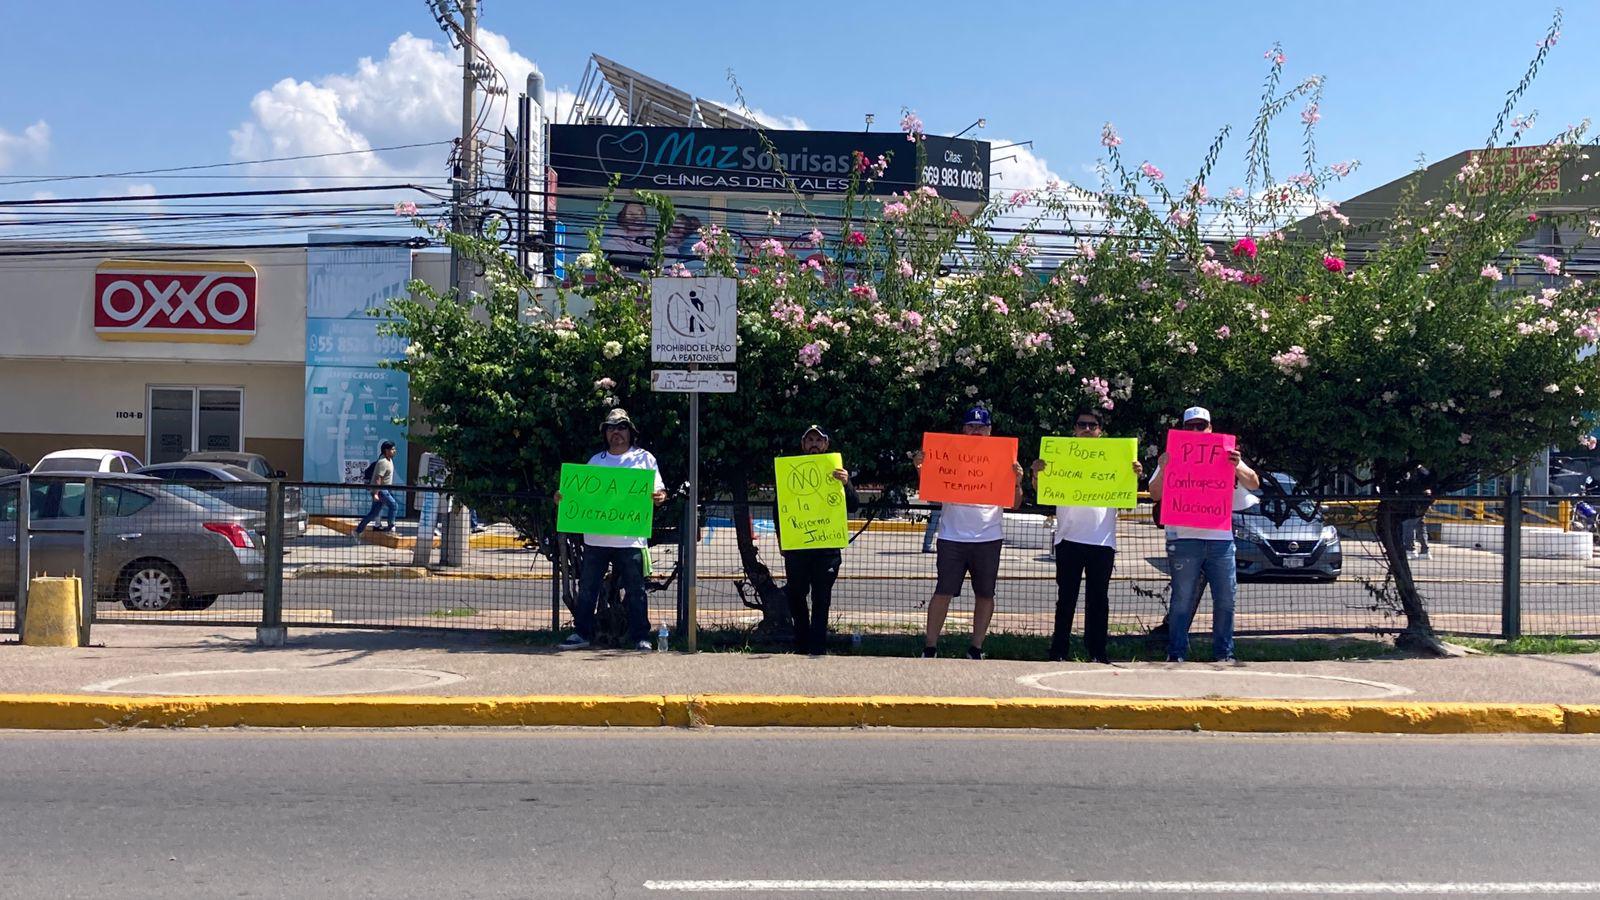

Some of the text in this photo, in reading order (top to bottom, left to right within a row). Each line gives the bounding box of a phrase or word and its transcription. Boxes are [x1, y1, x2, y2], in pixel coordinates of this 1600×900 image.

[653, 132, 738, 169] Maz
[746, 177, 850, 190] DENTALES
[941, 168, 959, 187] 983
[102, 277, 248, 327] OXXO
[656, 344, 732, 352] PROHIBIDO EL PASO
[116, 411, 143, 419] 1104-B
[605, 479, 618, 494] A
[628, 479, 648, 495] LA
[1172, 495, 1227, 517] Nacional
